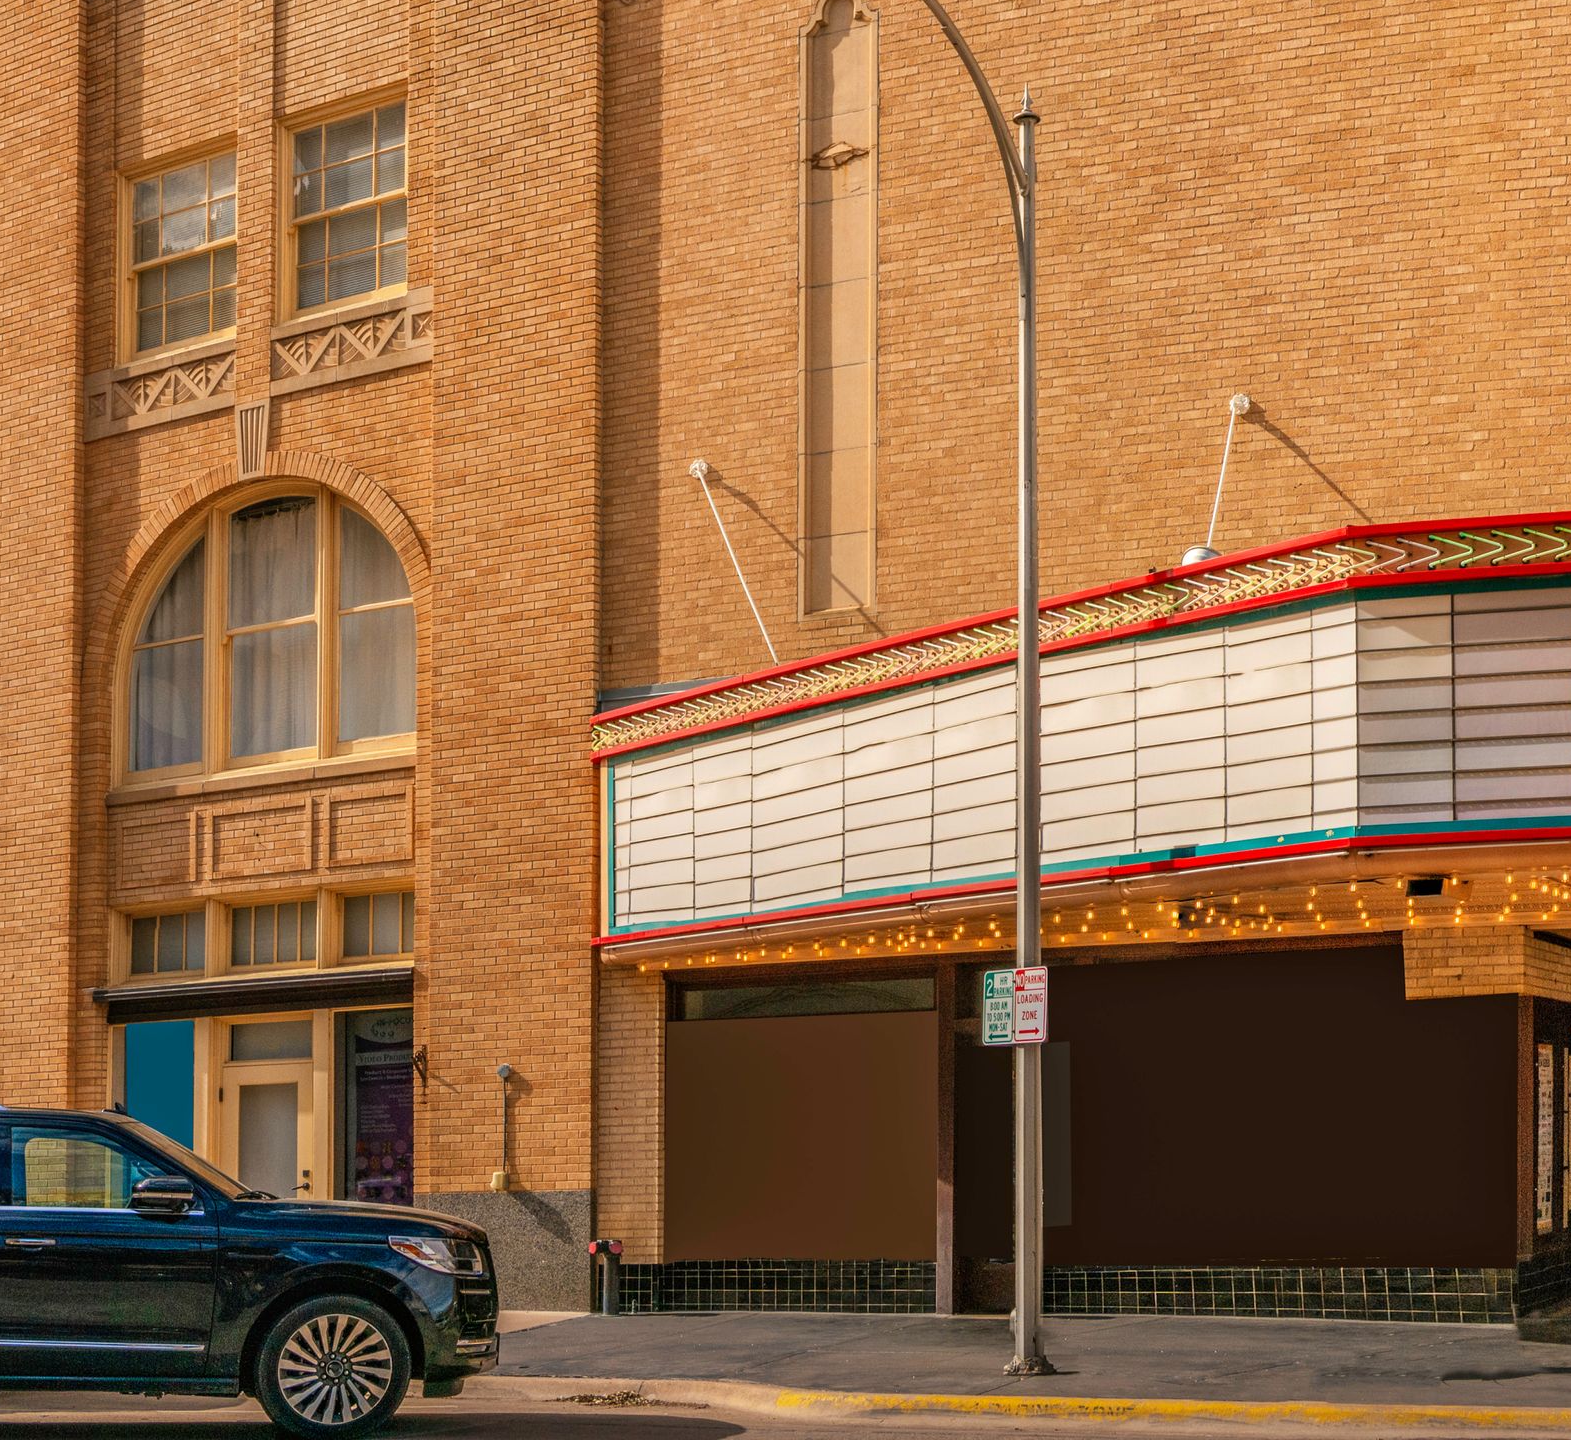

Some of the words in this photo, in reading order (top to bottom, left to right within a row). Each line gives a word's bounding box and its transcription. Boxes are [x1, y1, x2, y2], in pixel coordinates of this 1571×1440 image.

[1016, 973, 1025, 988] NO
[1025, 974, 1045, 984] PARKING
[986, 979, 993, 997] 2
[1000, 976, 1008, 985] HR
[994, 986, 1012, 996] PARKING
[1017, 993, 1043, 1004] LOADING
[1001, 1001, 1008, 1010] AM
[987, 1013, 992, 1022] TO
[1004, 1011, 1011, 1021] PM
[1022, 1010, 1038, 1020] ZONE
[989, 1022, 1008, 1032] MON-SAT
